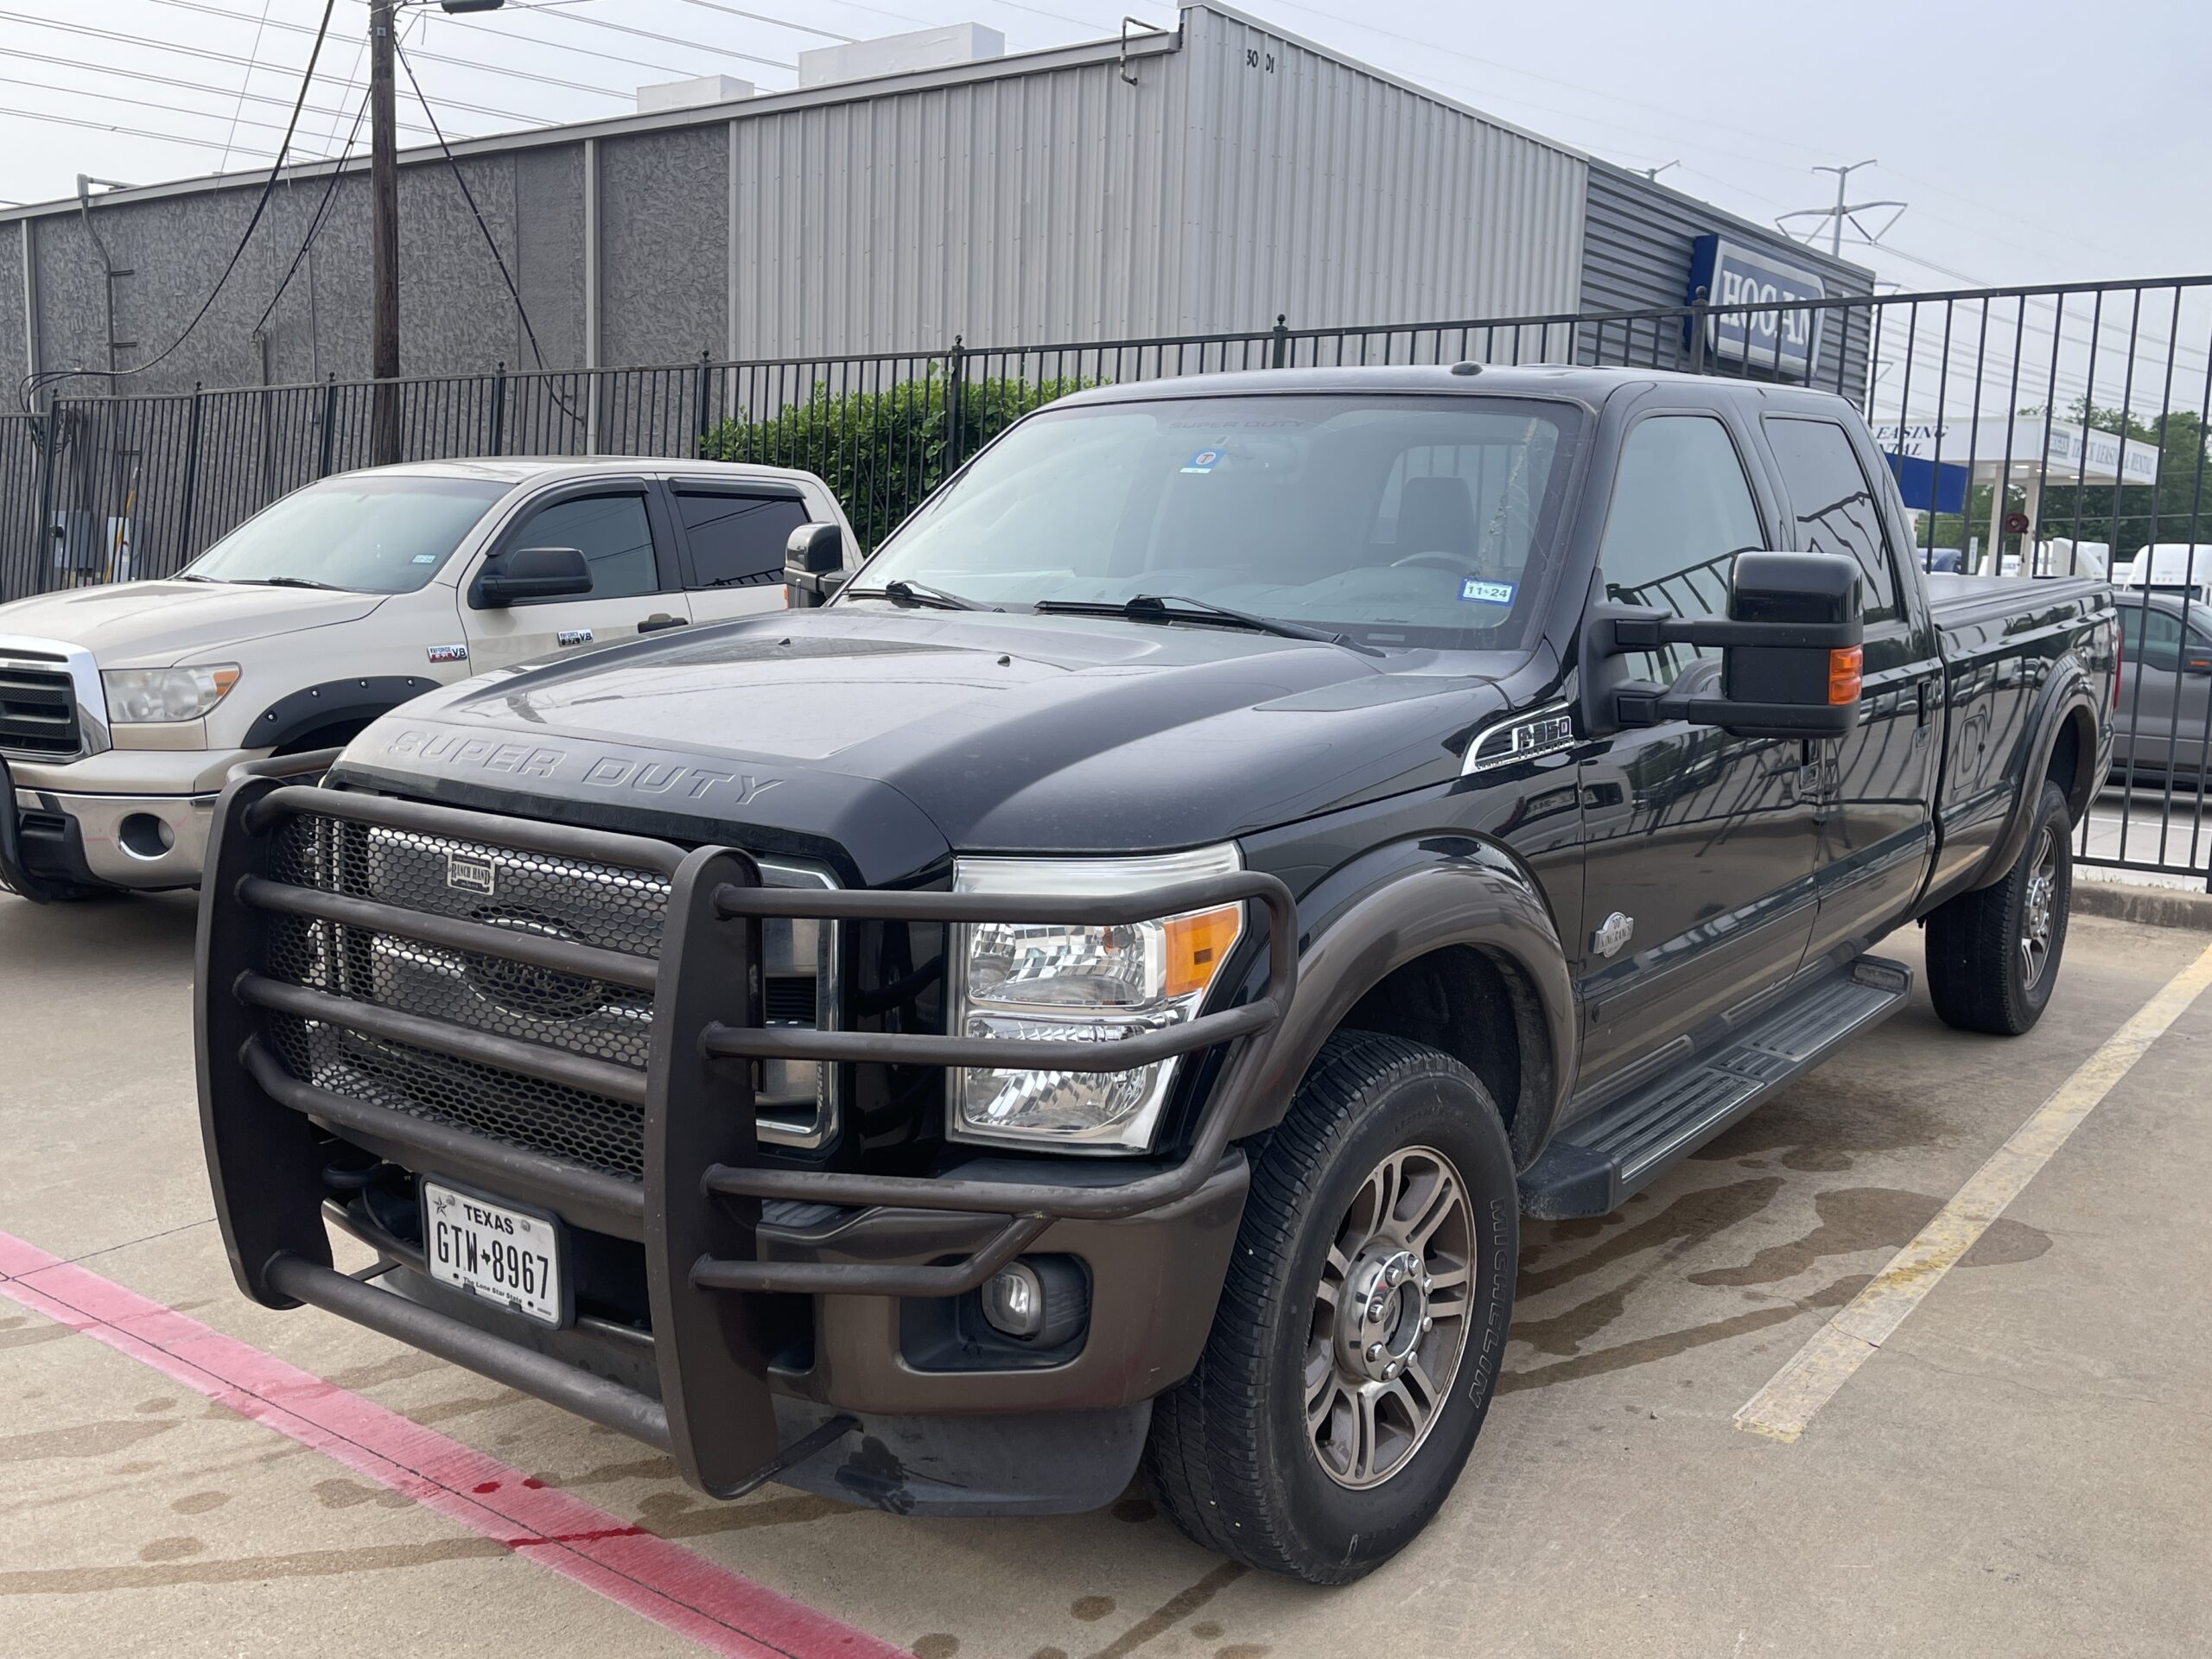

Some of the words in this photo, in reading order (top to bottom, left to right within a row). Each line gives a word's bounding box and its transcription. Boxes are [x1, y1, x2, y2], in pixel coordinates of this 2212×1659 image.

[1719, 269, 1818, 345] HOGAN
[1876, 425, 1949, 440] EASING
[580, 632, 593, 641] V8
[452, 648, 466, 657] V8
[387, 730, 568, 778] SUPER
[582, 756, 785, 805] DUTY
[451, 862, 471, 880] RANCH
[473, 867, 491, 886] HAND
[463, 1204, 514, 1236] TEXAS
[463, 1276, 474, 1286] The
[476, 1281, 491, 1292] Lone
[493, 1287, 505, 1296] Star
[506, 1292, 522, 1303] State
[1469, 1197, 1509, 1410] MICHELIN
